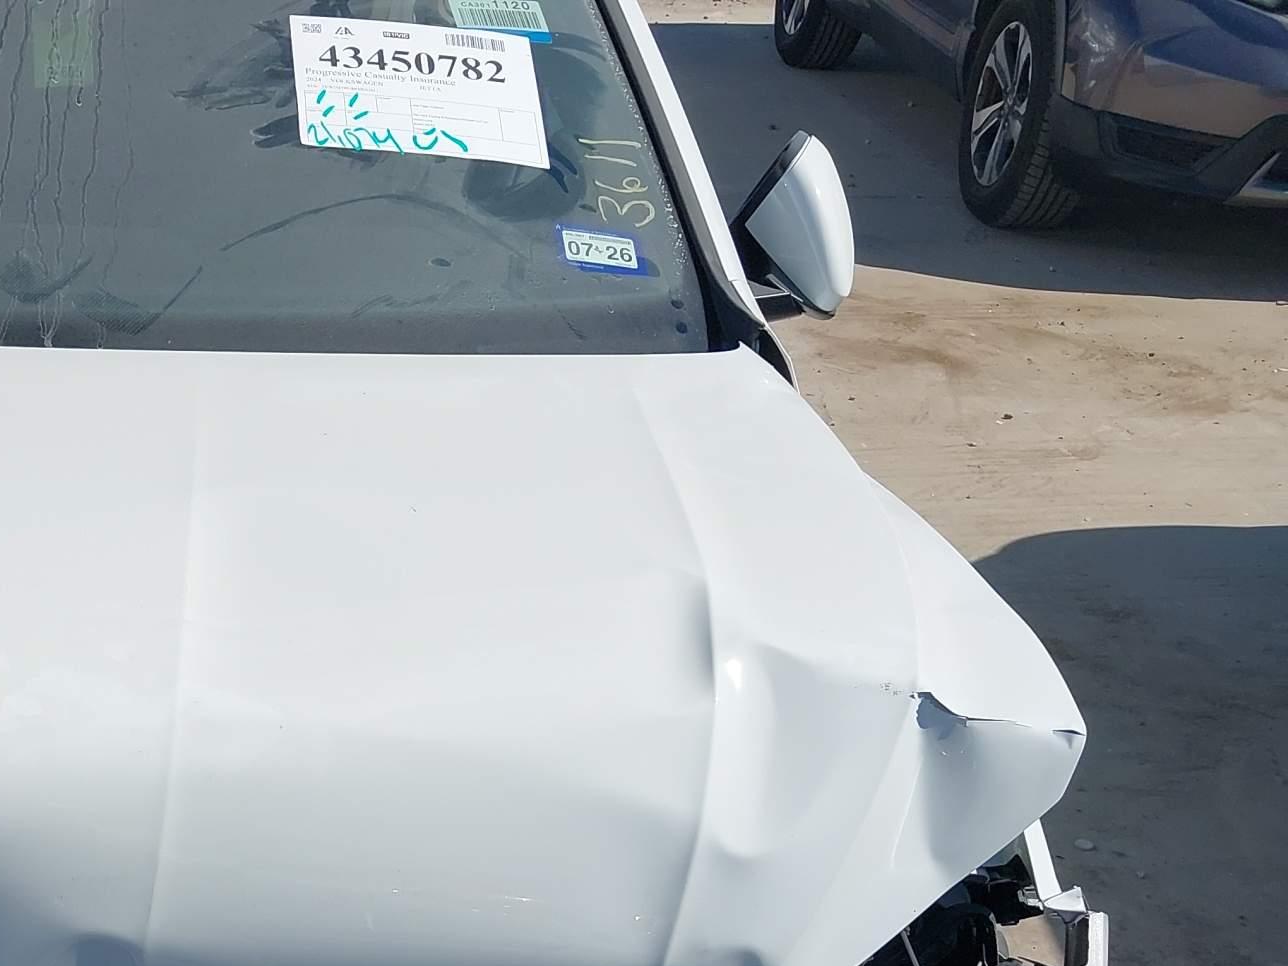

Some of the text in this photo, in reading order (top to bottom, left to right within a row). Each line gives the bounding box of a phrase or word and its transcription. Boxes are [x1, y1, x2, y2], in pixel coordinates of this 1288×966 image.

[305, 67, 456, 86] Progressive Casualty Insurance
[318, 44, 506, 84] 43450782
[578, 138, 656, 228] 3611
[567, 240, 593, 257] 07
[605, 246, 633, 263] 26
